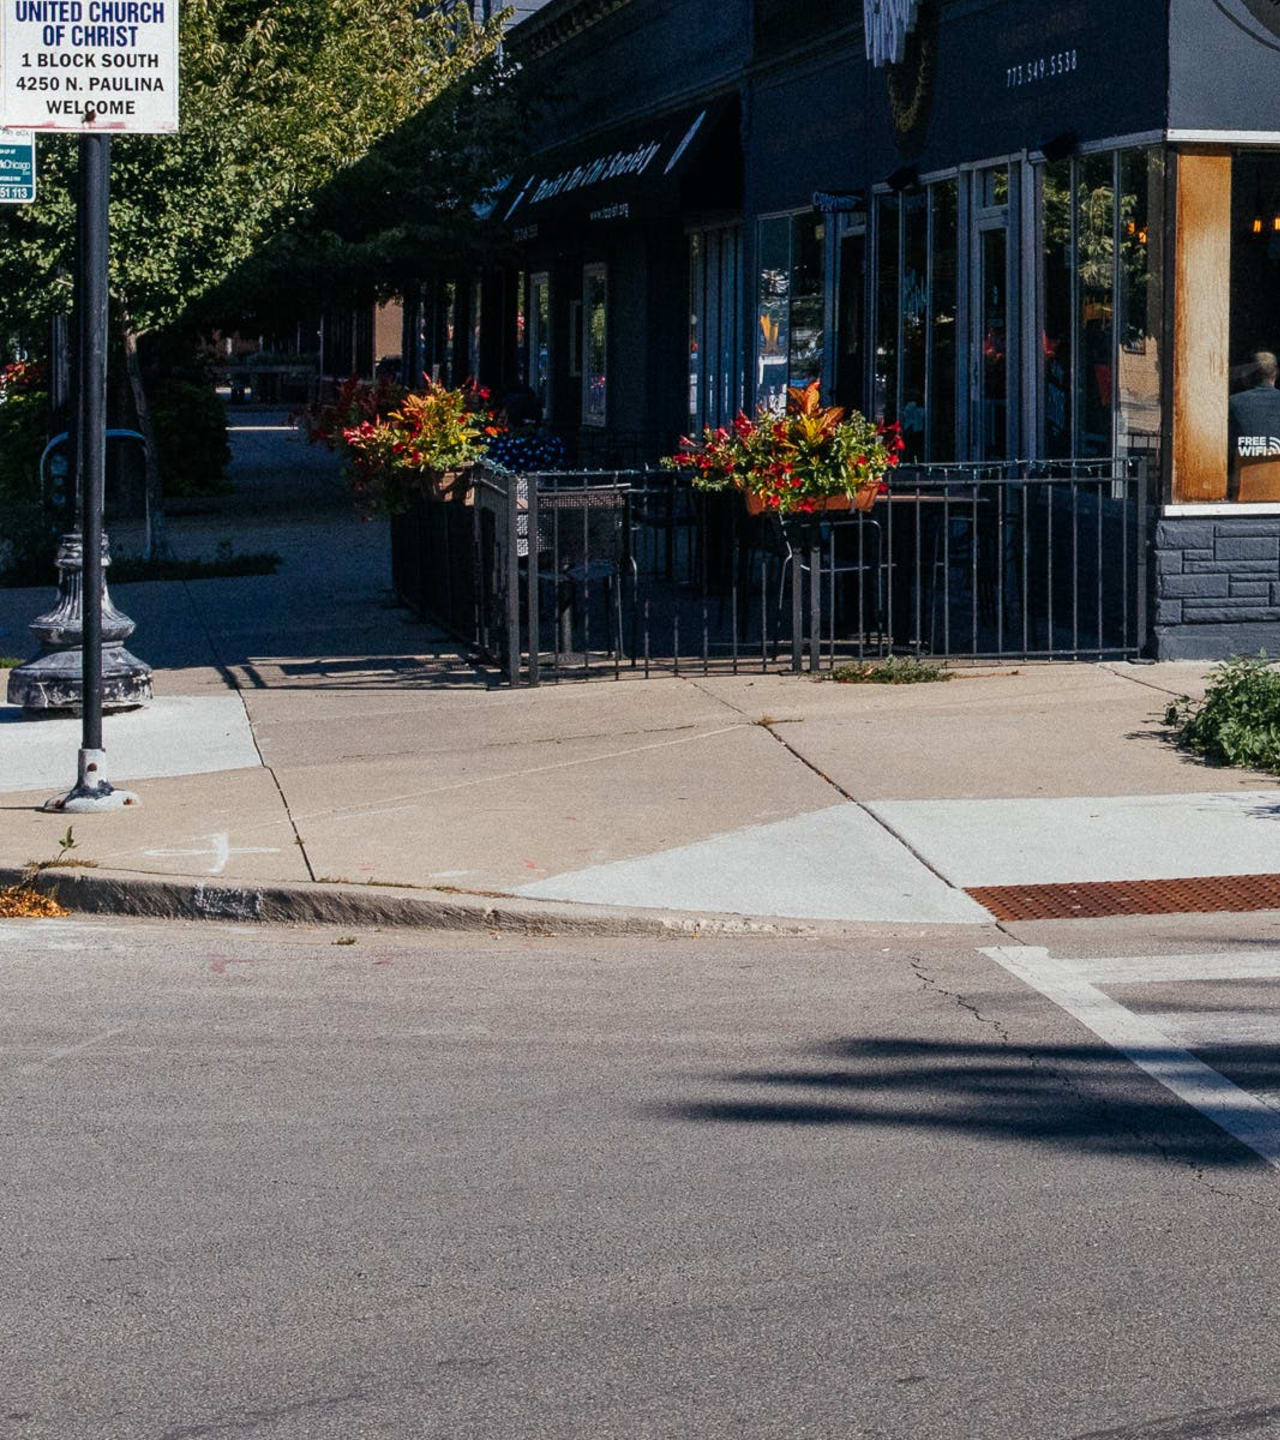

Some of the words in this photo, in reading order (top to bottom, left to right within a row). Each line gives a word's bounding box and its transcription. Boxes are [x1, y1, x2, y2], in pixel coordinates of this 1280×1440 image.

[16, 0, 82, 23] UNITED
[89, 0, 165, 24] CHURCH
[42, 25, 66, 47] OF
[72, 25, 139, 47] CHRIST
[22, 53, 31, 68] 1
[37, 53, 97, 68] BLOCK
[102, 53, 159, 69] SOUTH
[16, 77, 60, 92] 4250
[65, 77, 83, 92] N.
[89, 77, 165, 92] PAULINA
[46, 100, 136, 115] WELCOME
[1237, 436, 1266, 446] FREE
[1237, 446, 1267, 456] WIFI
